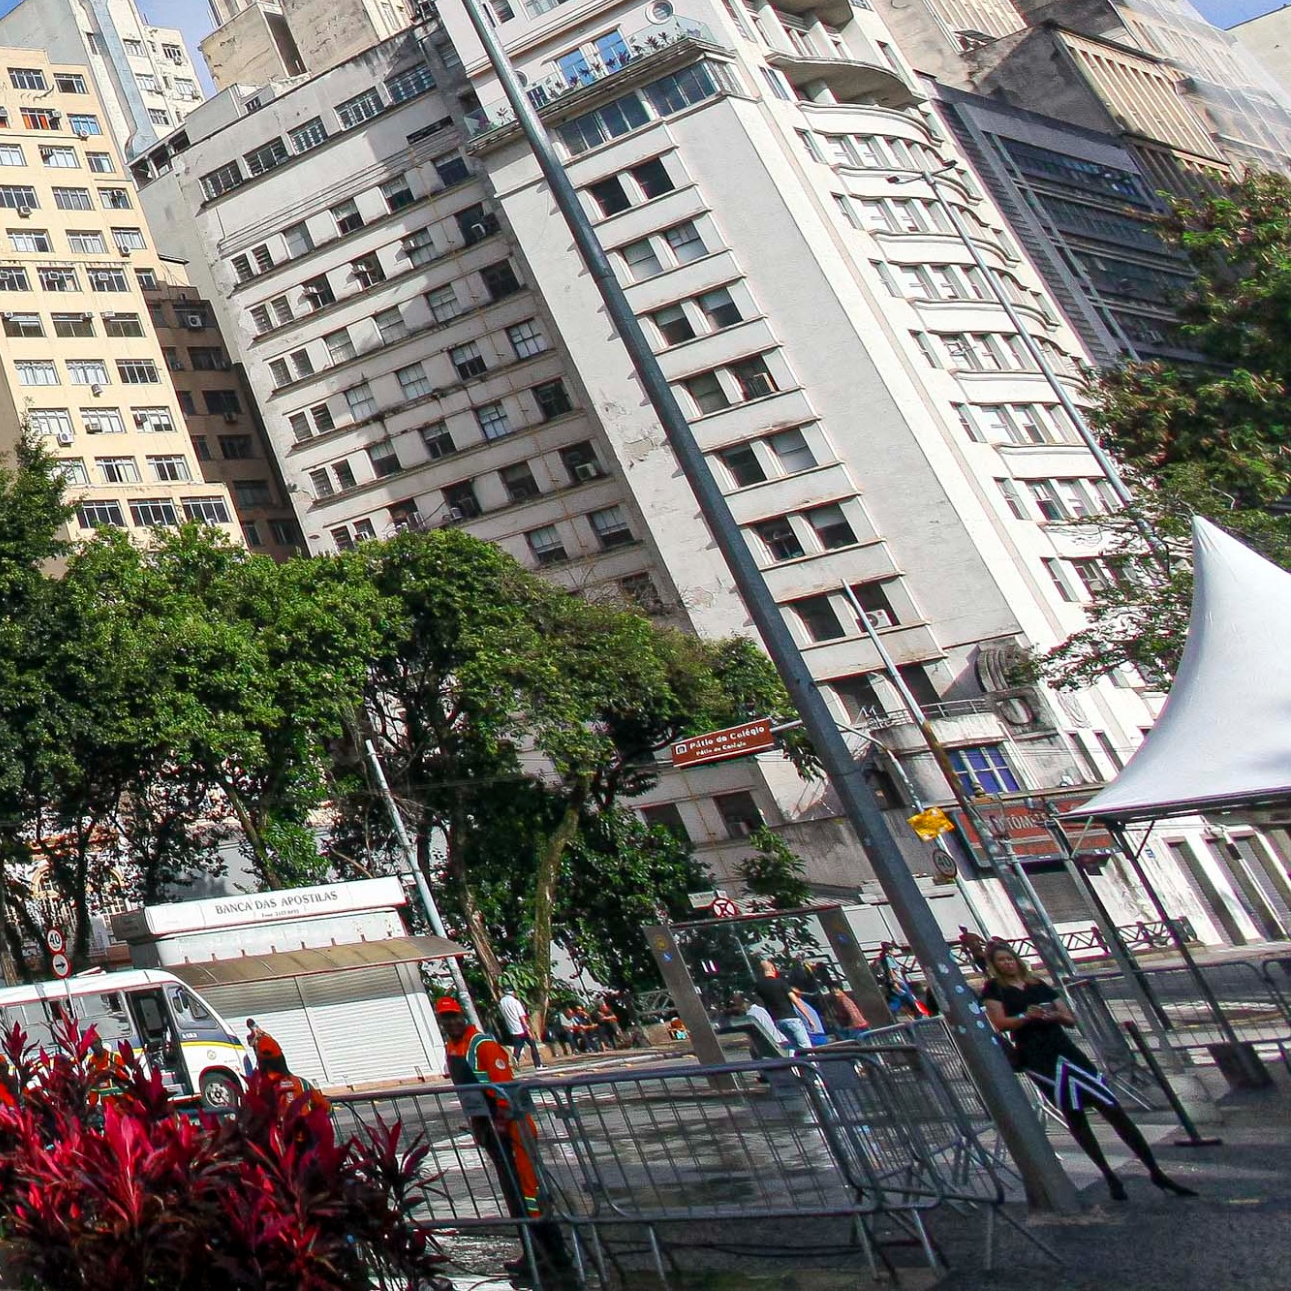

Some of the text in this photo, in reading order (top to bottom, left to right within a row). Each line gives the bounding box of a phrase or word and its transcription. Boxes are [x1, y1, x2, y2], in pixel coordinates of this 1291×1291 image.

[689, 738, 713, 749] Pátio
[729, 726, 765, 740] Colégio
[937, 855, 953, 869] 40
[215, 890, 339, 915] BANCA DAS APOSTILAS
[49, 933, 61, 946] 40
